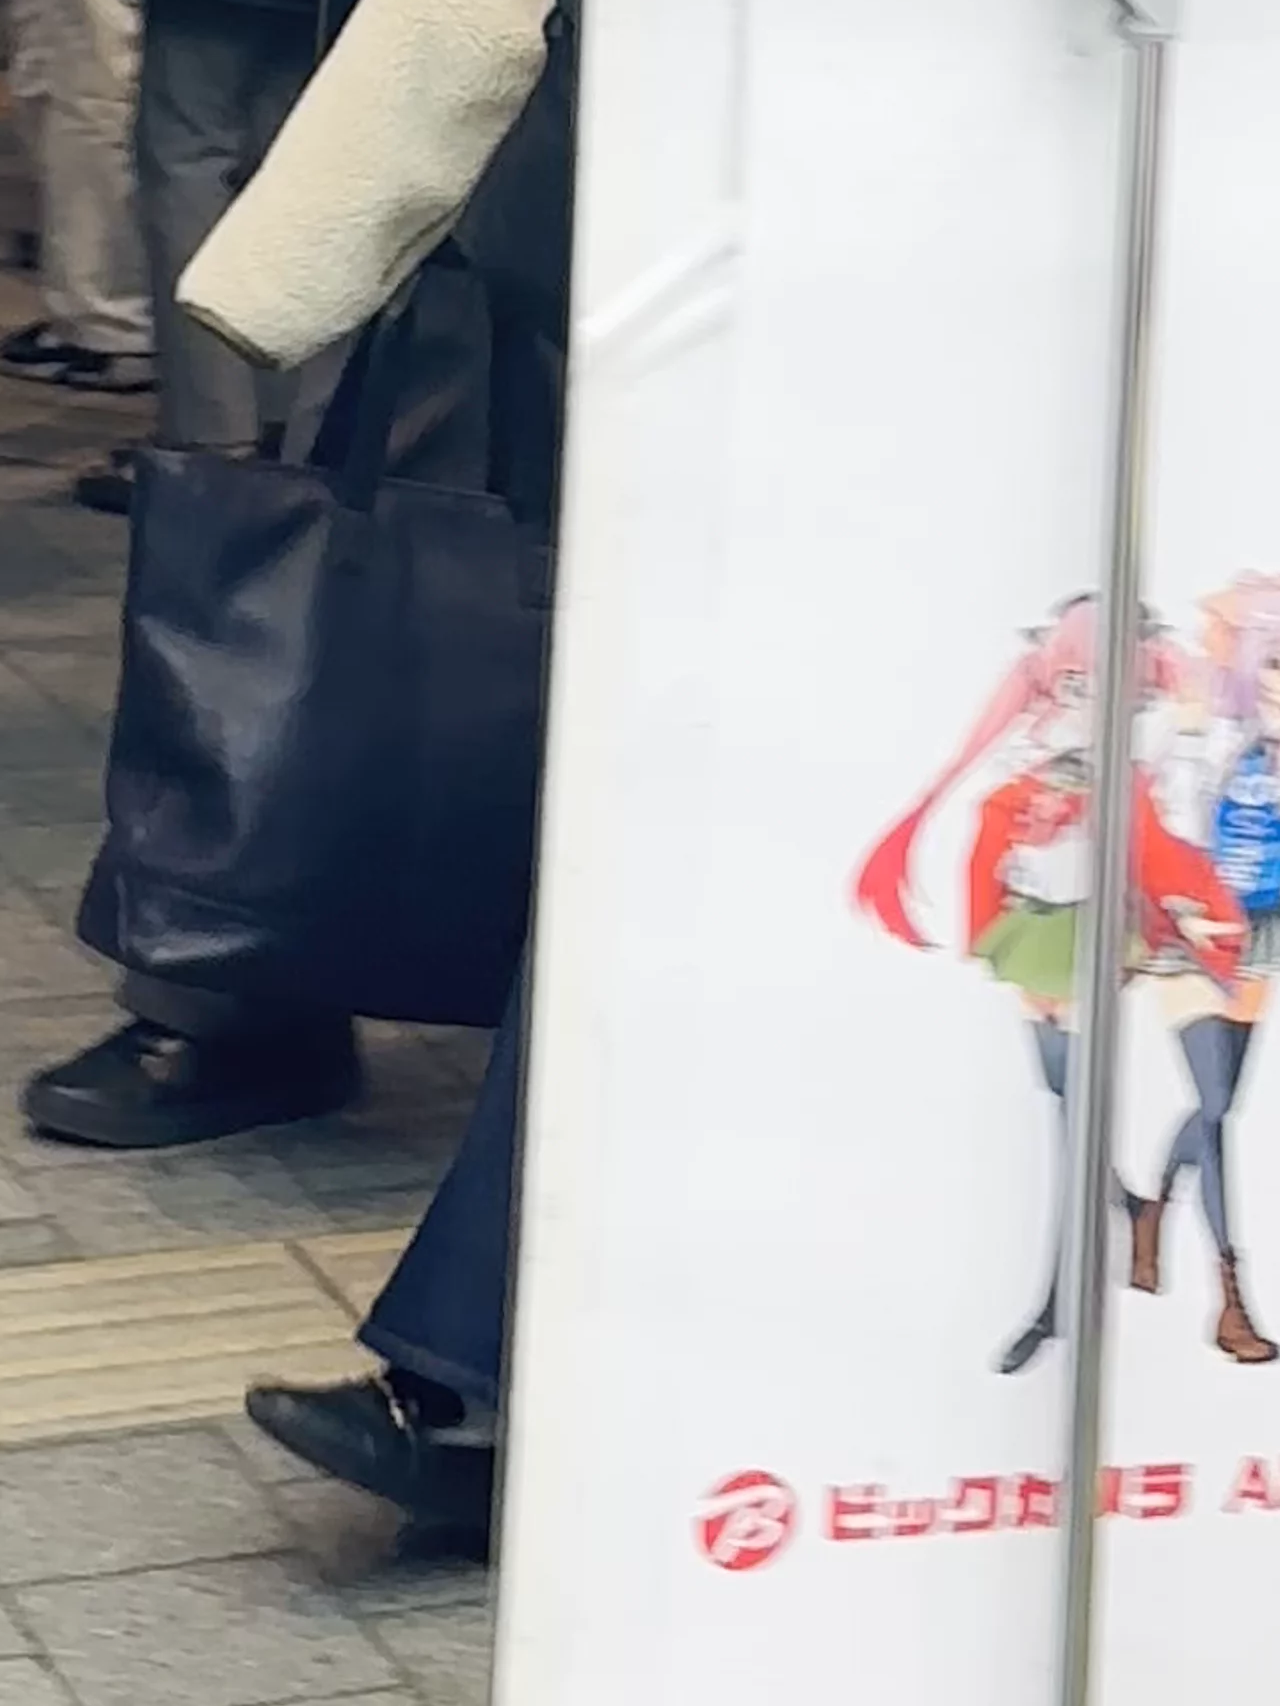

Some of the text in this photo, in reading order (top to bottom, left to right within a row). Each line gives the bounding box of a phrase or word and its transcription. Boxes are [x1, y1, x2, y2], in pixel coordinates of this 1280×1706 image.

[824, 1460, 1194, 1544] ビックカラ
